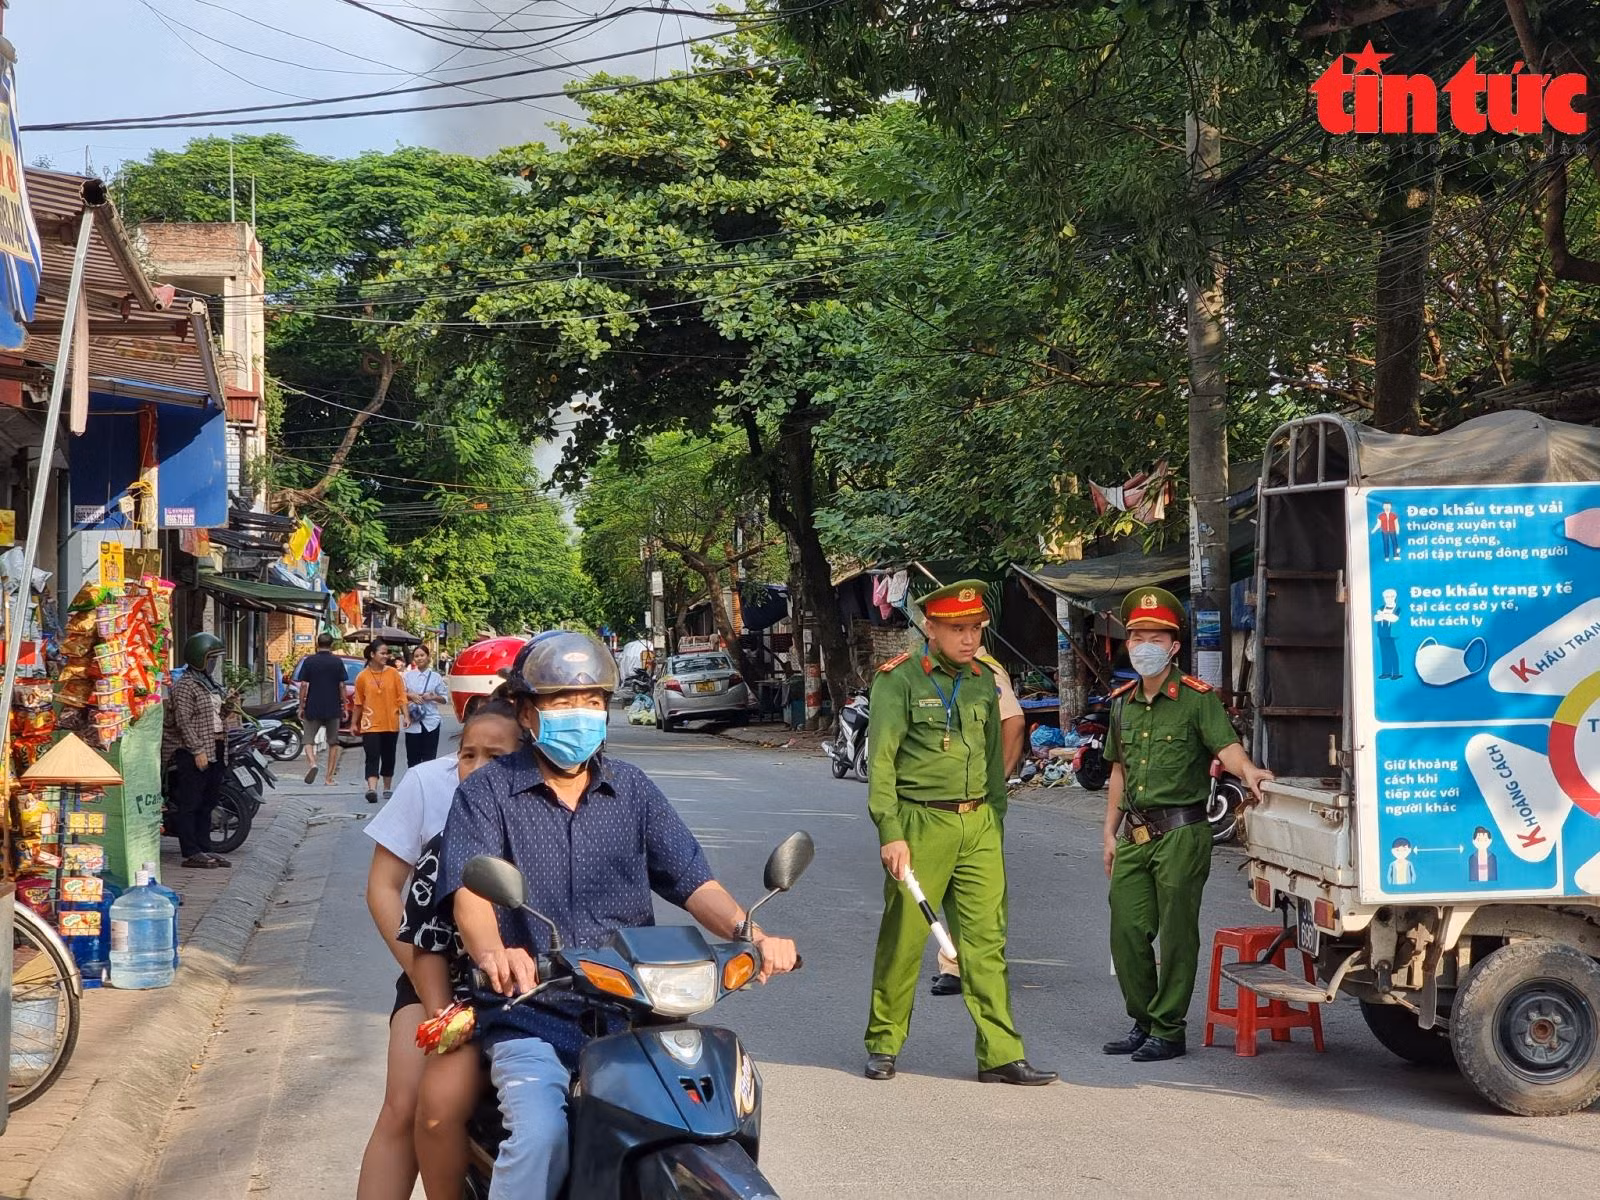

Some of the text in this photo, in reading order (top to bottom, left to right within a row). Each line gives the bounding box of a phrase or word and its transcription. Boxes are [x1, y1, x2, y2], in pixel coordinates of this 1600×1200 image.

[1407, 500, 1563, 517] Đeo khẩu trang vải
[1407, 518, 1517, 532] thường xuyên tại
[1408, 534, 1500, 546] nơi công cộng,
[1408, 545, 1568, 561] nơi tập trung đông người
[1410, 580, 1573, 597] Đeo khẩu trang y tế
[1410, 599, 1518, 614] tại các cơ sở y tế,
[1410, 614, 1483, 627] khu cách ly
[1509, 646, 1566, 683] KHẨU
[1384, 758, 1458, 771] Giữ khoảng
[1384, 773, 1438, 784] cách khi
[1385, 787, 1460, 800] tiếp xúc với
[1486, 744, 1546, 849] KHOẢNG CÁCH
[1386, 801, 1457, 816] người khác
